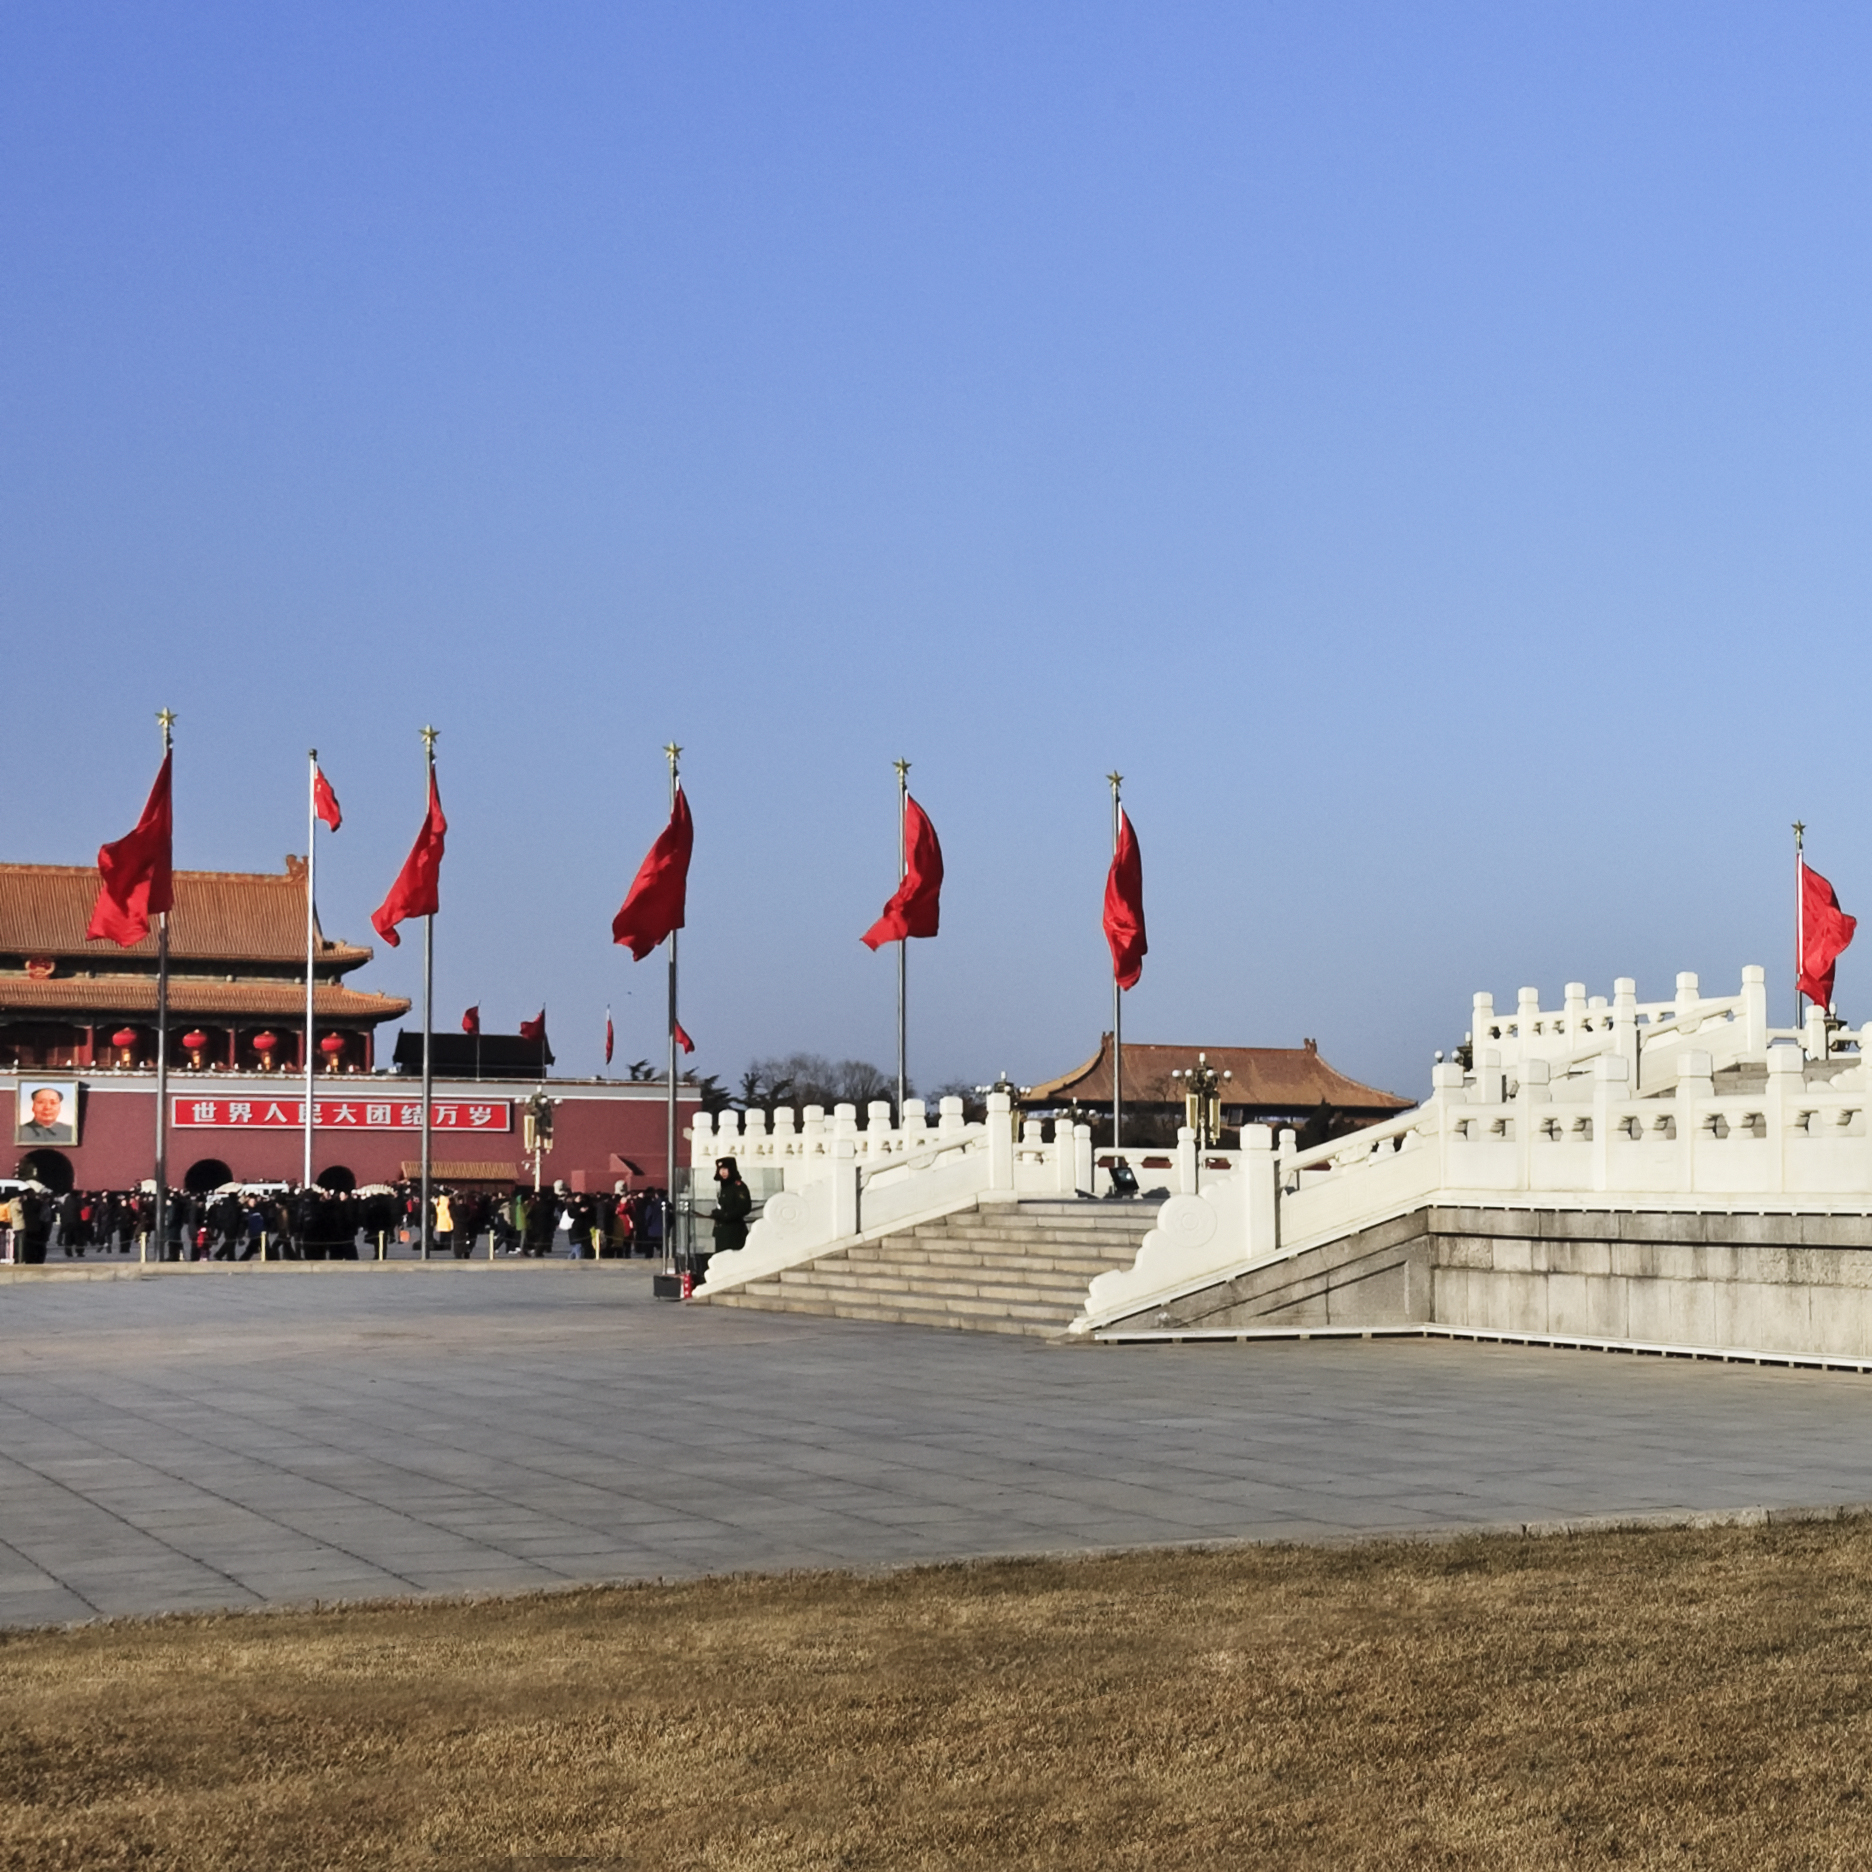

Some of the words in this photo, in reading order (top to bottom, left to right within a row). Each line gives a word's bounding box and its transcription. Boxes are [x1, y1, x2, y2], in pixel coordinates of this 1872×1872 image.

[191, 1102, 493, 1127] 世界人民大团结万岁
